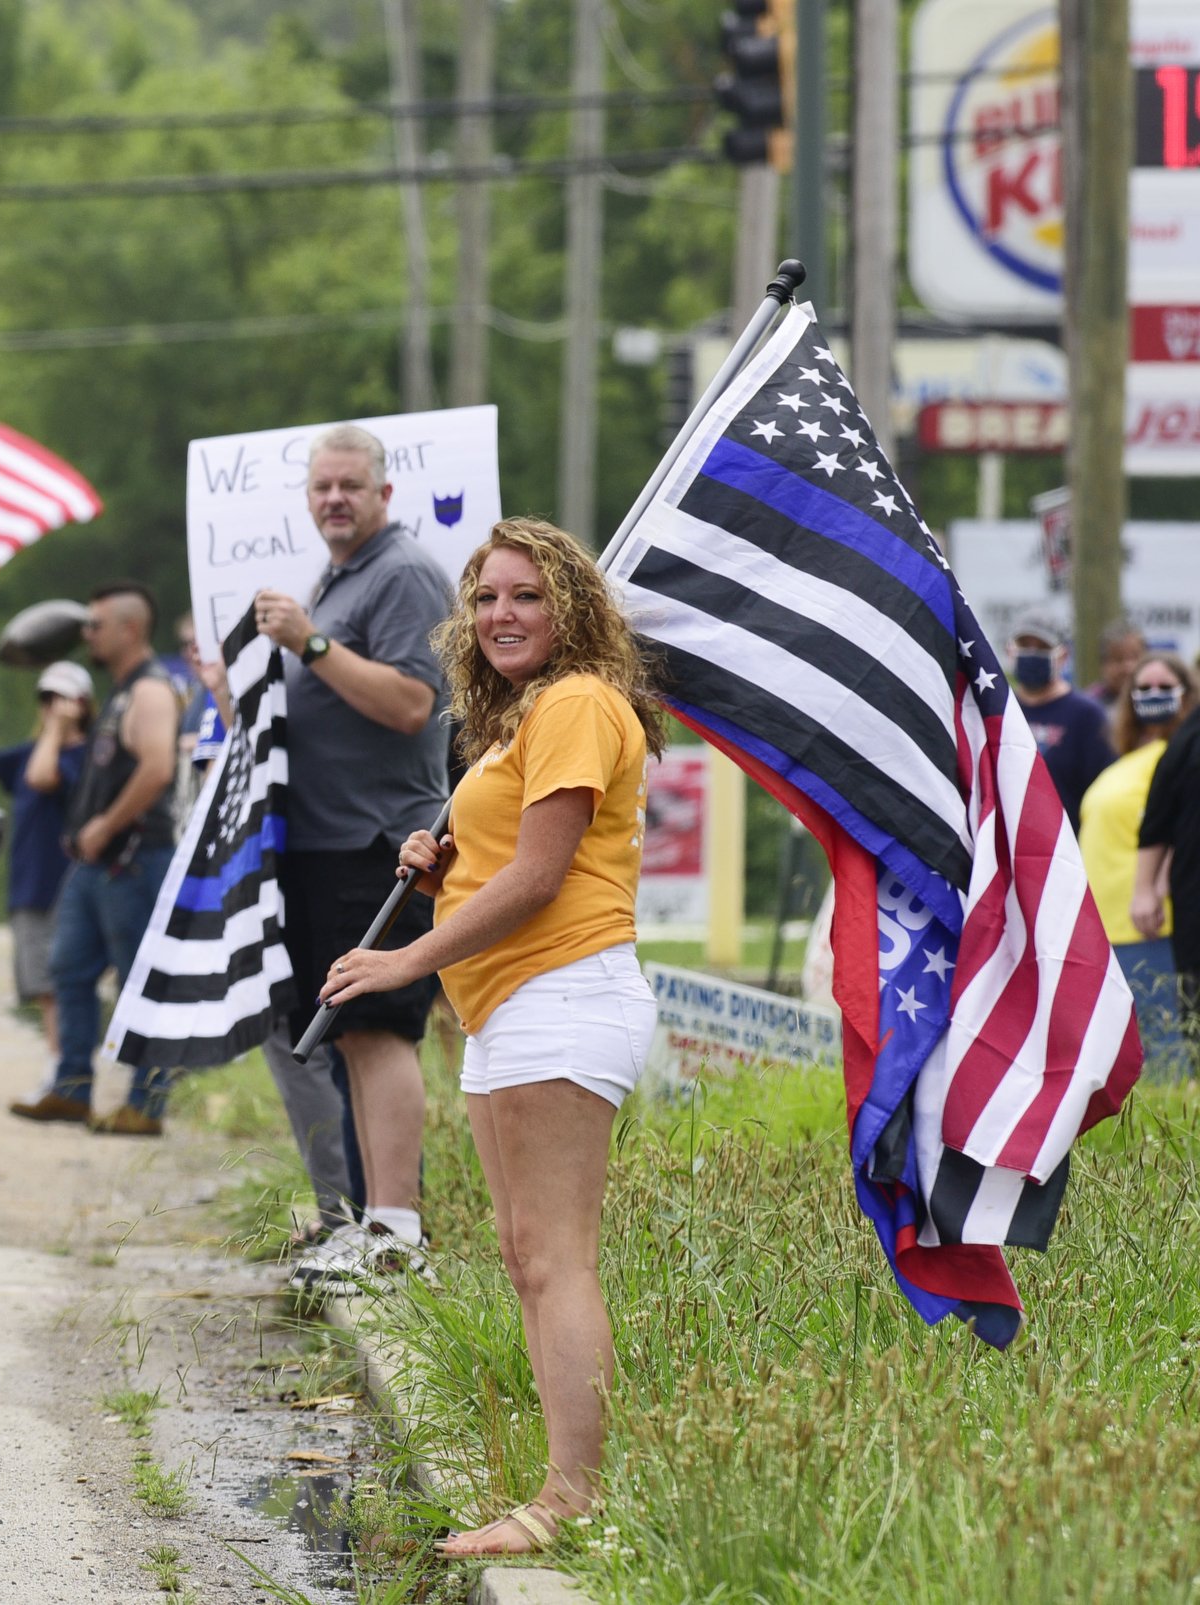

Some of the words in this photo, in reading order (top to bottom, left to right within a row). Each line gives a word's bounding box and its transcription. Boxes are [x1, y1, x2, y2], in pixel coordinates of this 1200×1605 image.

[200, 444, 263, 495] WE
[207, 514, 308, 568] LOCAL
[655, 972, 725, 1015] PAVING
